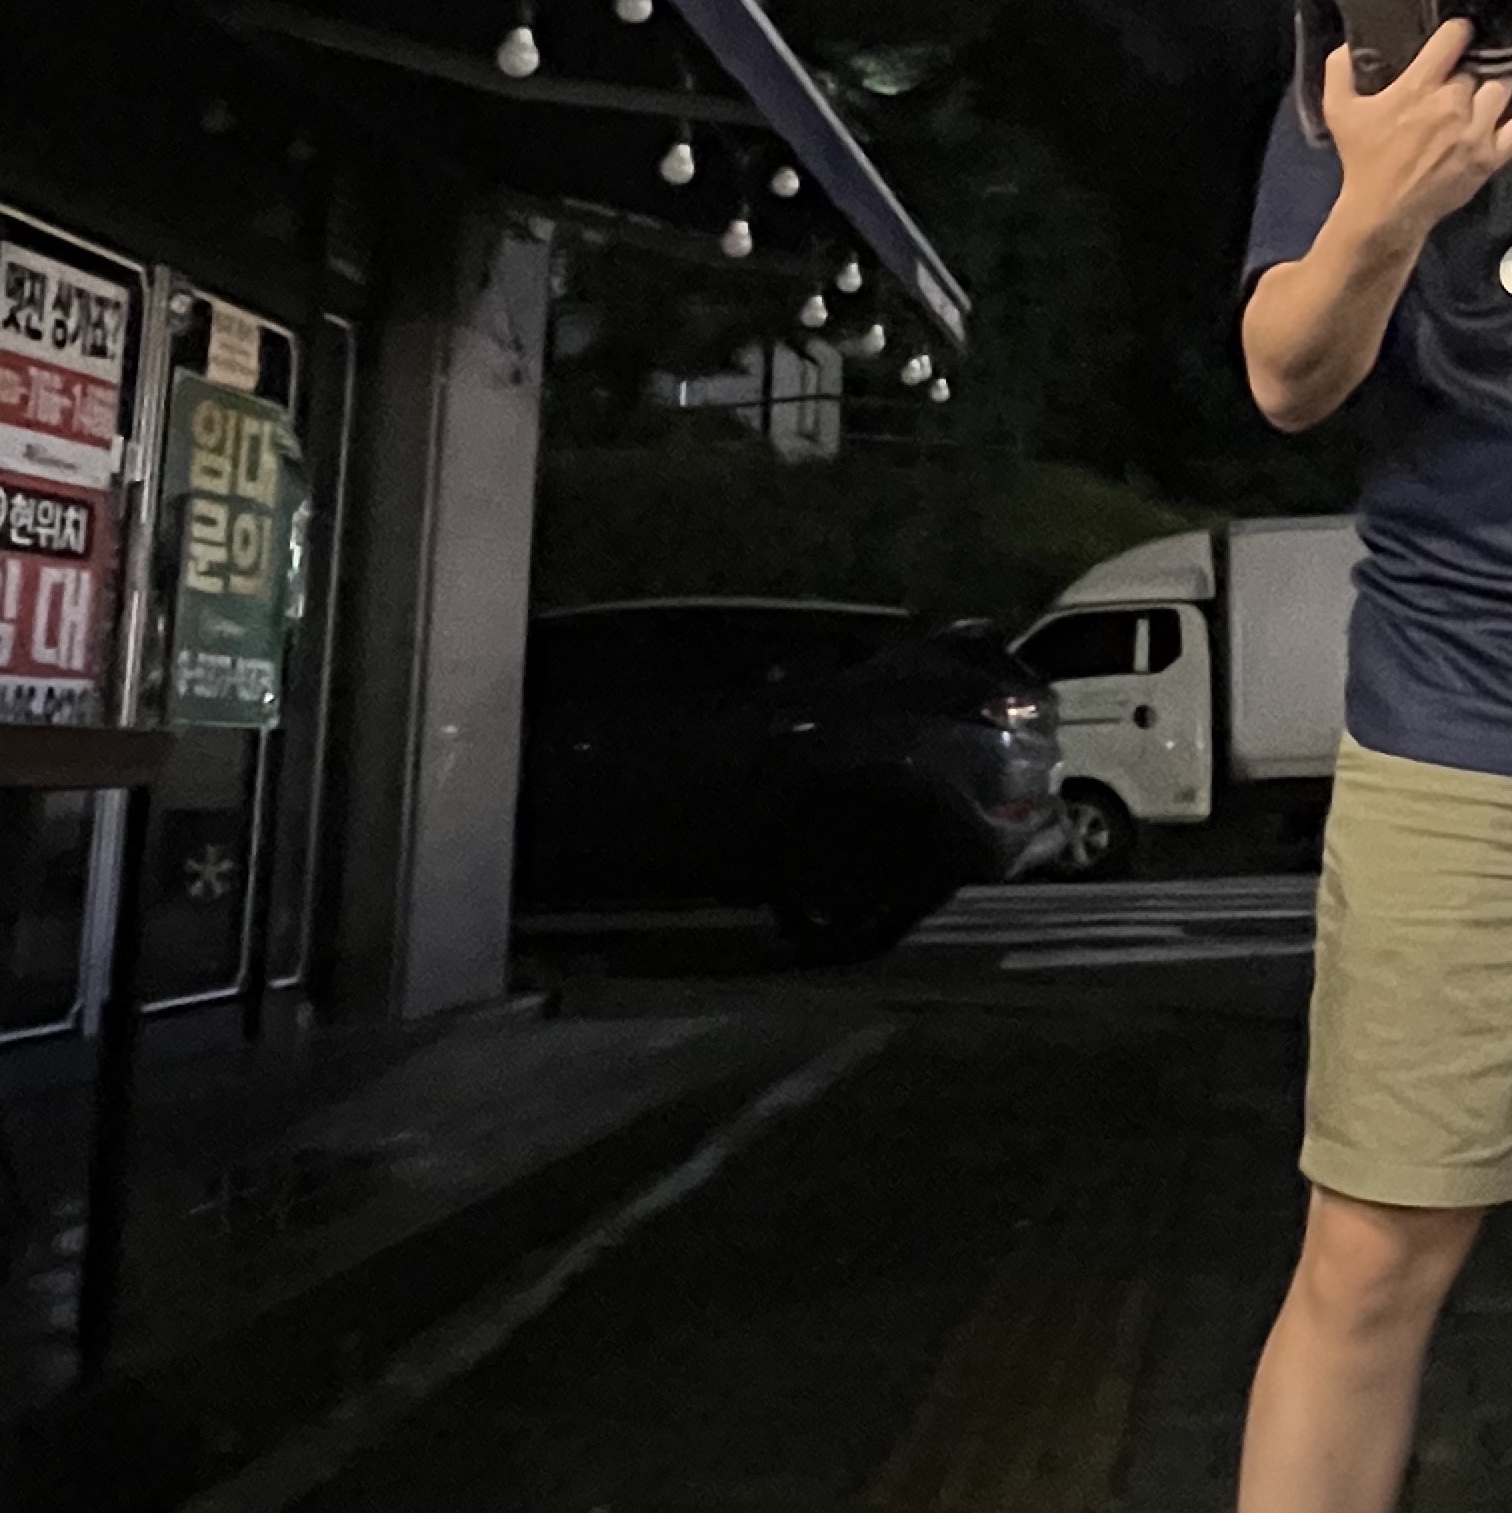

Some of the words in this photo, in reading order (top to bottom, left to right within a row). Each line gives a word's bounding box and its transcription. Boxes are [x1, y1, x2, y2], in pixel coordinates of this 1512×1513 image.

[190, 399, 278, 508] 임대
[10, 492, 88, 554] 현위치
[187, 497, 272, 595] 문의
